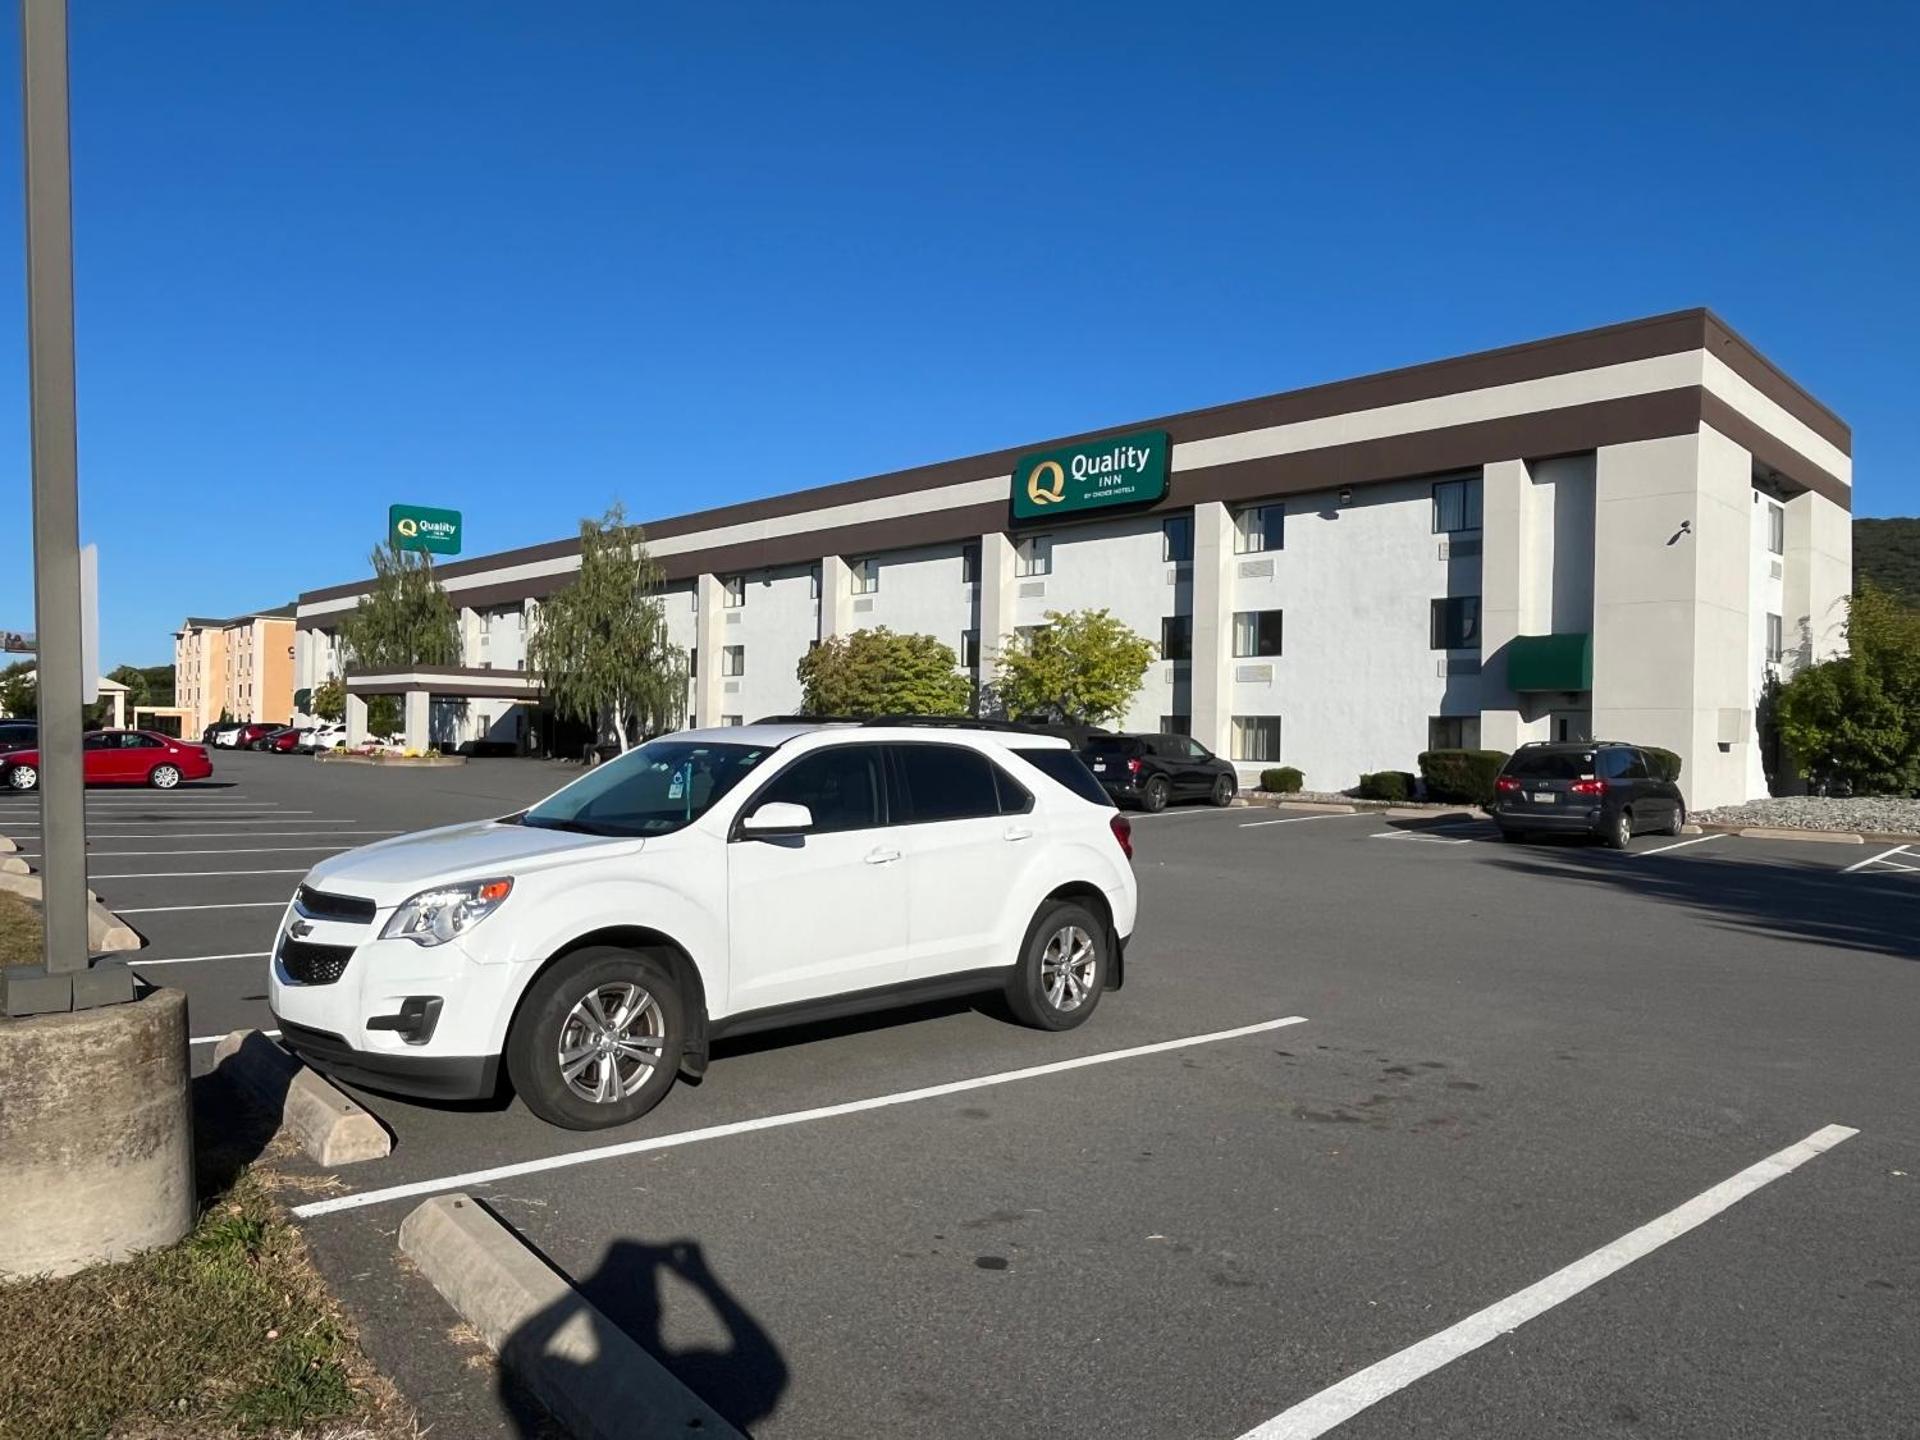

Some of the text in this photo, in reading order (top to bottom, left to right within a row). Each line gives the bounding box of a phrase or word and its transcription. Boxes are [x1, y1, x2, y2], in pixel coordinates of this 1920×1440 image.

[1072, 447, 1150, 480] Quality
[1028, 461, 1065, 504] Q
[1099, 474, 1122, 487] INN
[398, 519, 418, 536] Q
[419, 520, 456, 534] Quality
